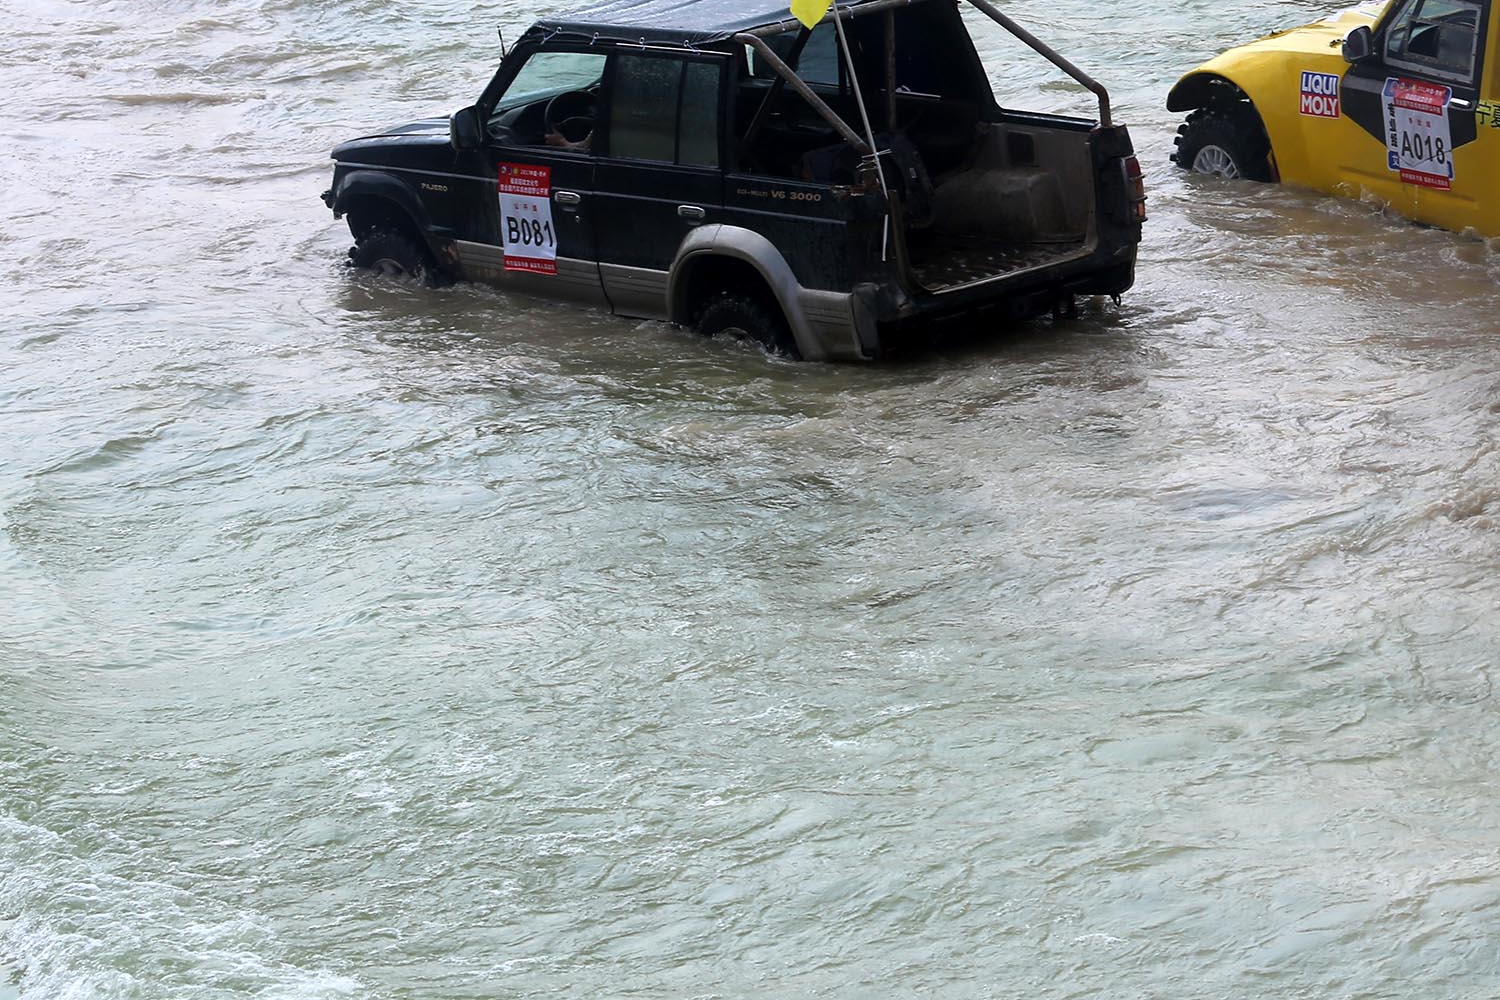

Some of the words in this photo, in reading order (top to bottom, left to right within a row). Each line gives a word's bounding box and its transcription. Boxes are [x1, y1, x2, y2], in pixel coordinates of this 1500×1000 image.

[1301, 73, 1338, 96] LIQUI
[1301, 94, 1338, 116] MOLY
[1401, 130, 1446, 165] A018
[770, 189, 786, 200] V6
[789, 191, 822, 202] 3000
[506, 216, 554, 248] B081
